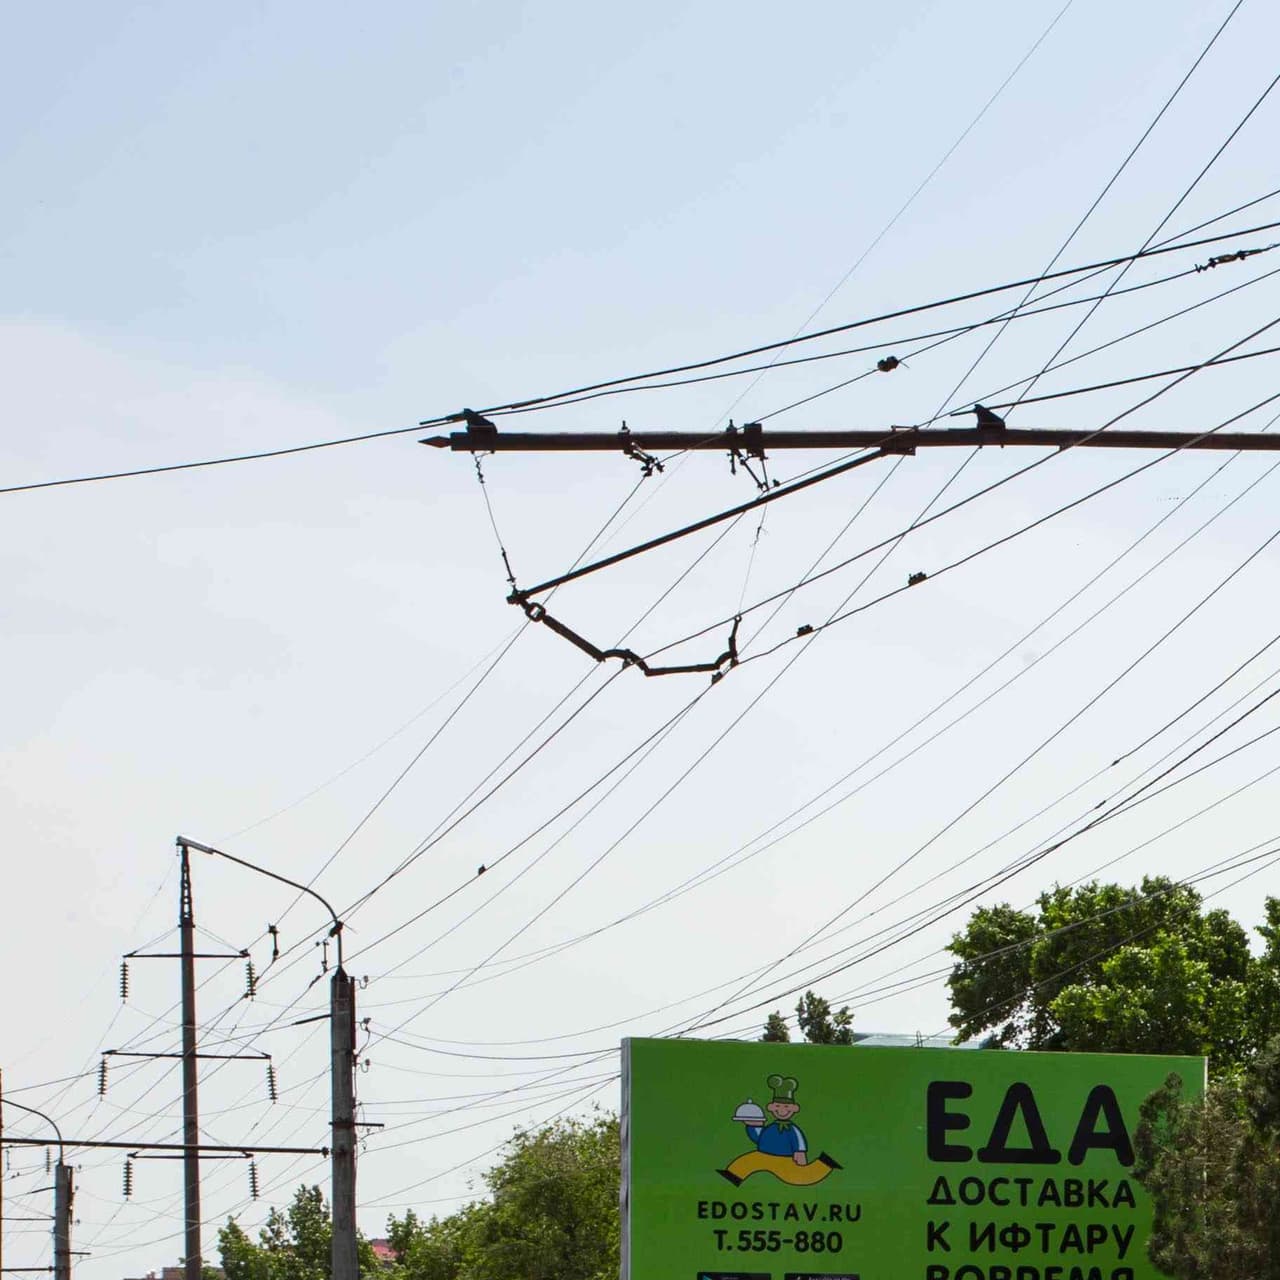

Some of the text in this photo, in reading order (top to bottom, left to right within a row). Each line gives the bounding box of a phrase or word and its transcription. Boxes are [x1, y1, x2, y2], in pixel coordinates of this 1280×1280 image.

[926, 1080, 1136, 1167] ЕДА
[926, 1175, 1136, 1209] ДОСТАВКА
[697, 1200, 862, 1223] EDOSTAV.RU
[927, 1221, 1136, 1260] К ИФТАРУ
